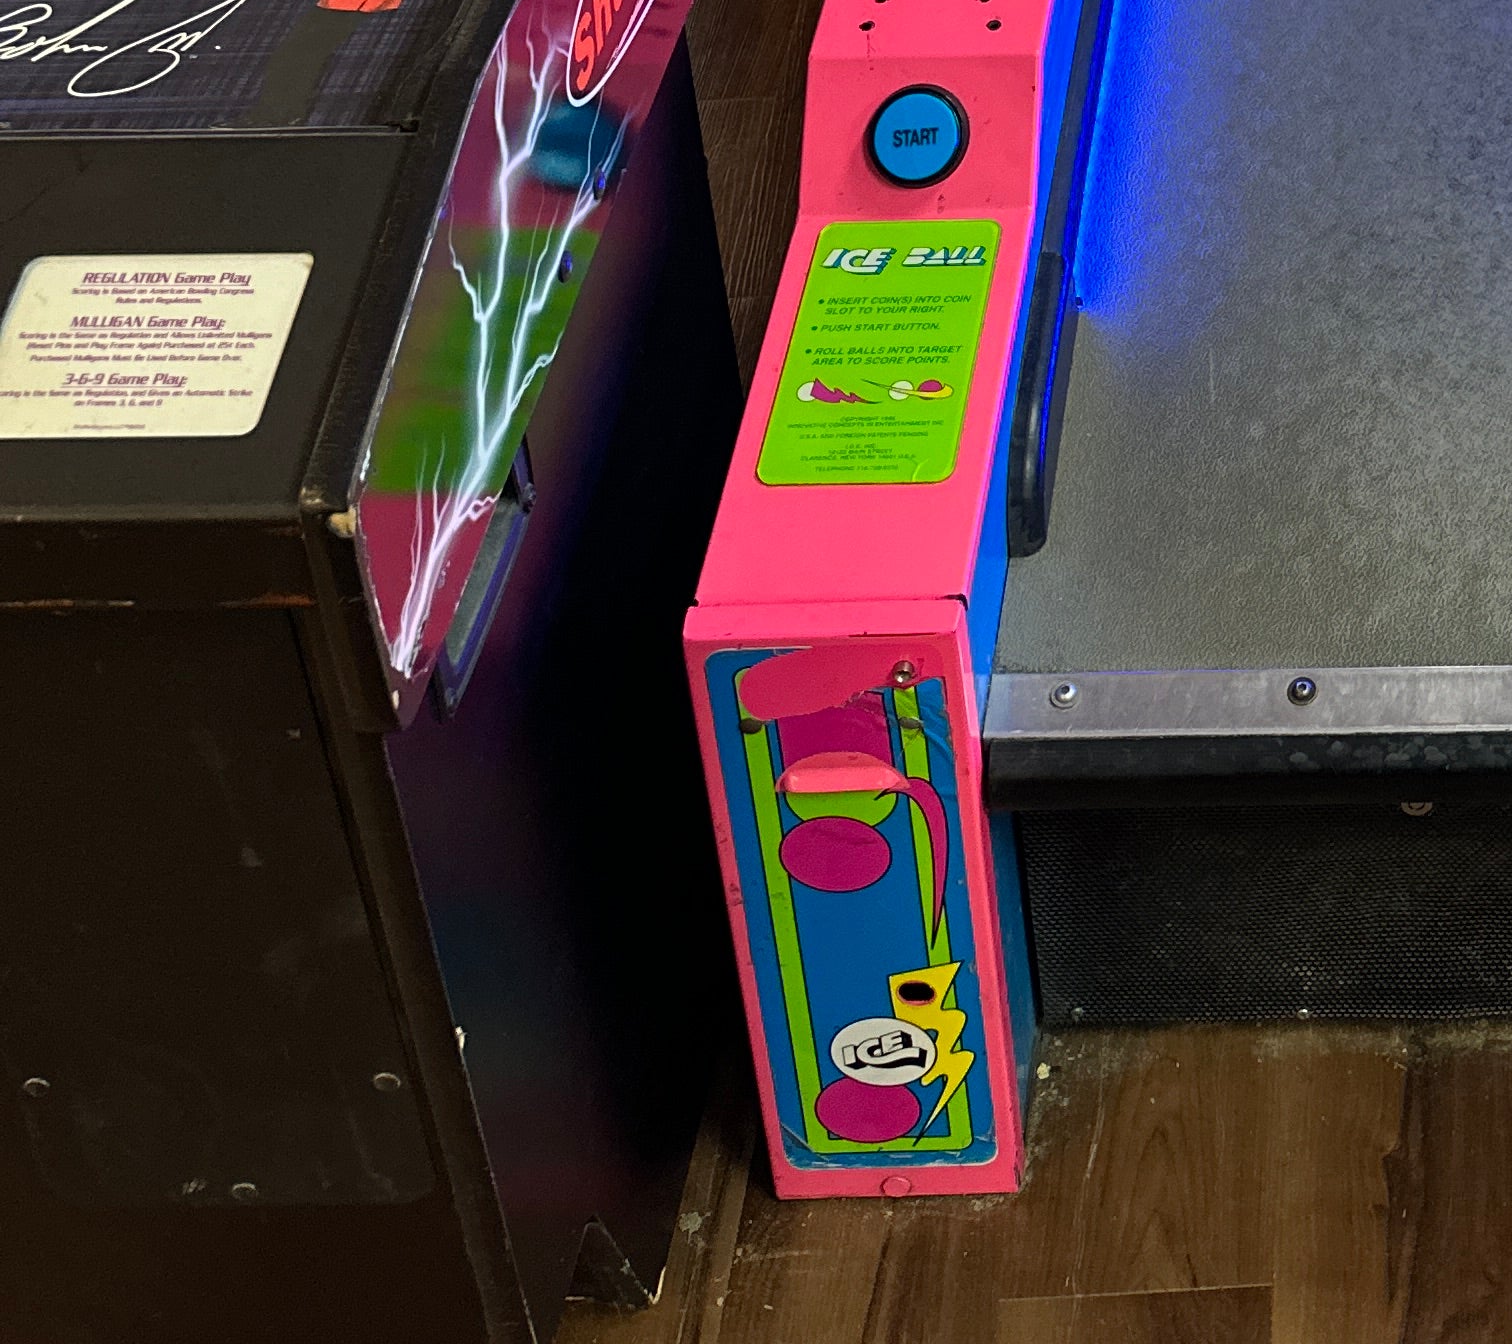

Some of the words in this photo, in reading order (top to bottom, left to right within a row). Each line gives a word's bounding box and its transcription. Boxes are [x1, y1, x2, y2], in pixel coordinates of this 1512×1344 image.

[892, 127, 938, 149] START
[822, 247, 897, 275] ICE
[902, 246, 987, 267] BALL
[82, 272, 170, 284] REGULATION
[174, 272, 215, 284] Game
[219, 272, 252, 285] Play
[827, 297, 868, 305] INSERT
[871, 296, 912, 304] COIN(S)
[944, 295, 972, 303] COIN
[825, 307, 855, 315] SLOT
[877, 306, 908, 314] YOUR
[70, 316, 143, 328] MULLIGAN
[147, 316, 187, 328] Game
[191, 316, 226, 330] Play:
[821, 324, 851, 332] PUSH
[887, 346, 914, 354] INTO
[917, 345, 962, 353] TARGET
[812, 357, 842, 365] AREA
[907, 356, 950, 364] POINTS.
[64, 373, 105, 385] 3-6-9
[107, 373, 147, 385] Game
[152, 373, 188, 387] Play:
[842, 1027, 928, 1072] ICE
